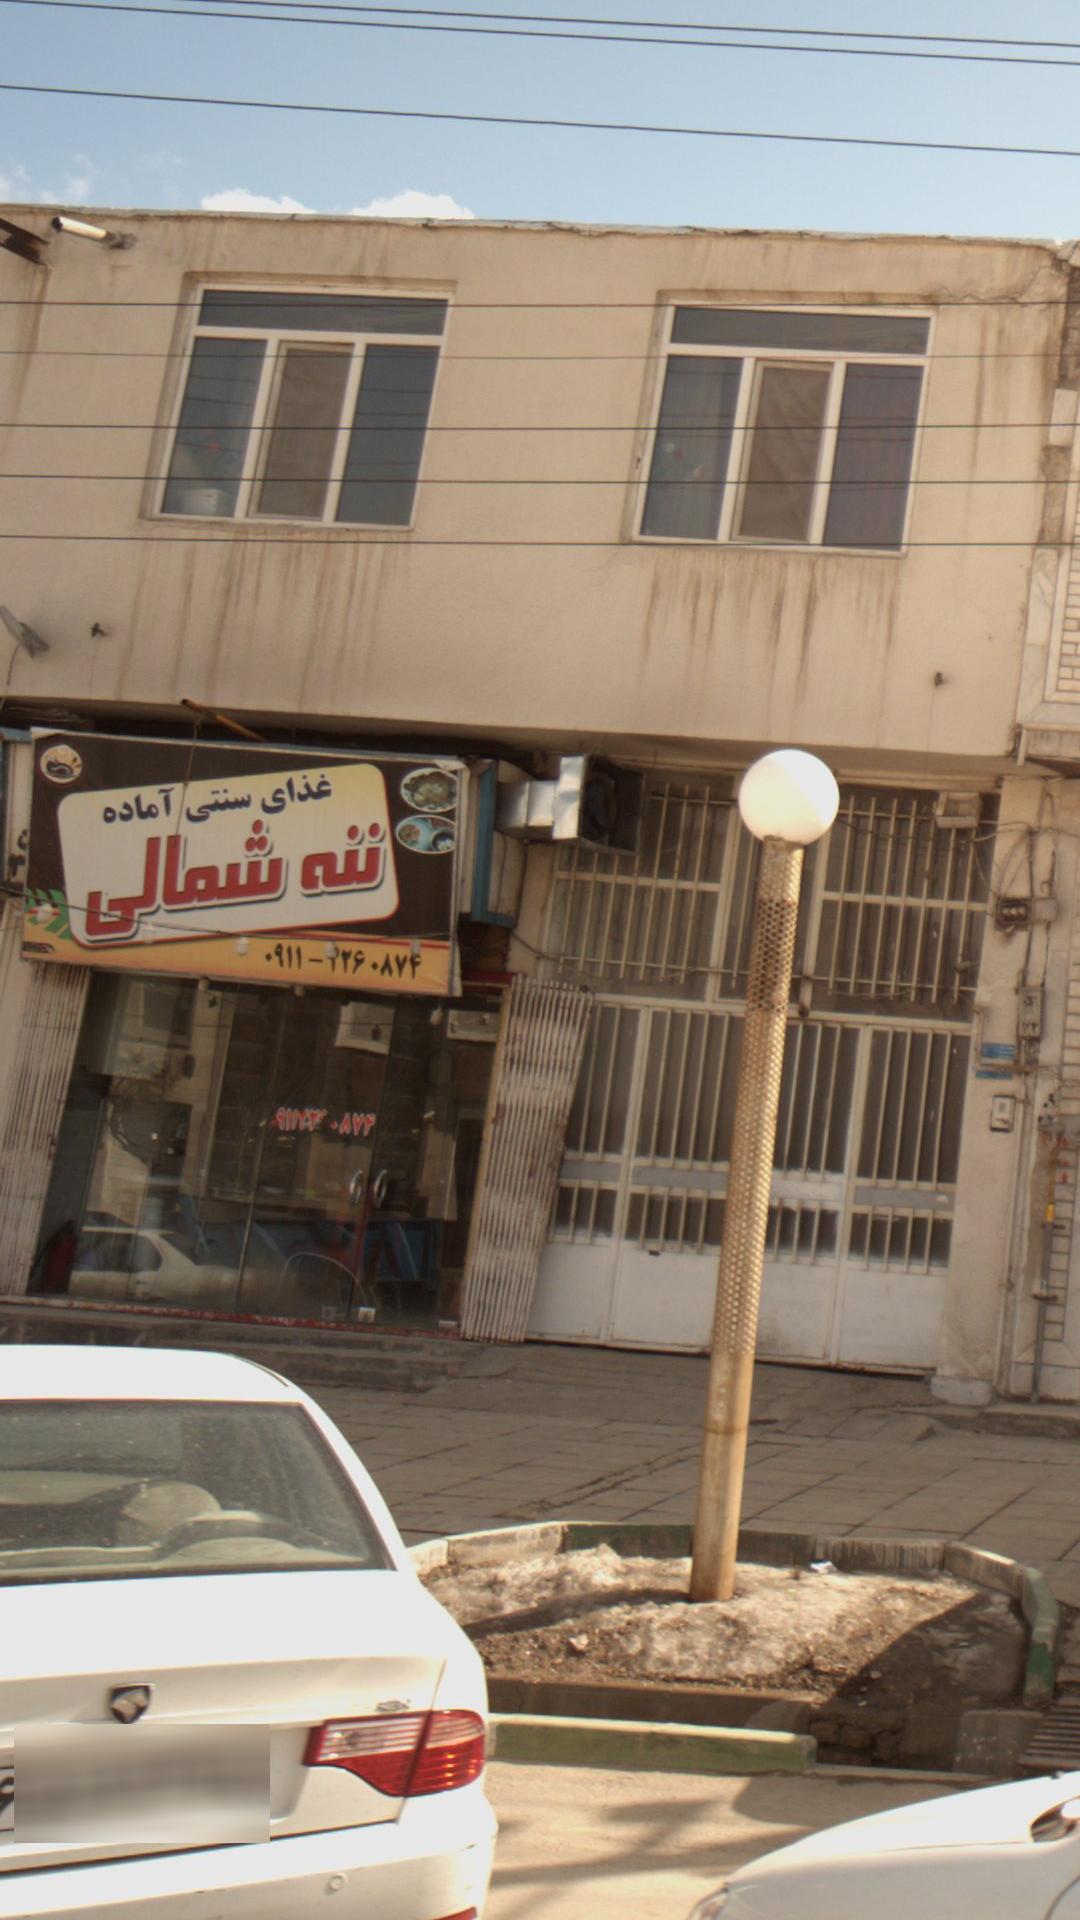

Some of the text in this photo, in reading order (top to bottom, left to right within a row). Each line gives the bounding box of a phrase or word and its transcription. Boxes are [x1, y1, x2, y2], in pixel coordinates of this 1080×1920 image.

[102, 774, 332, 823] غذای سنتی آماده
[84, 819, 284, 936] شمالی
[300, 822, 382, 891] ننه
